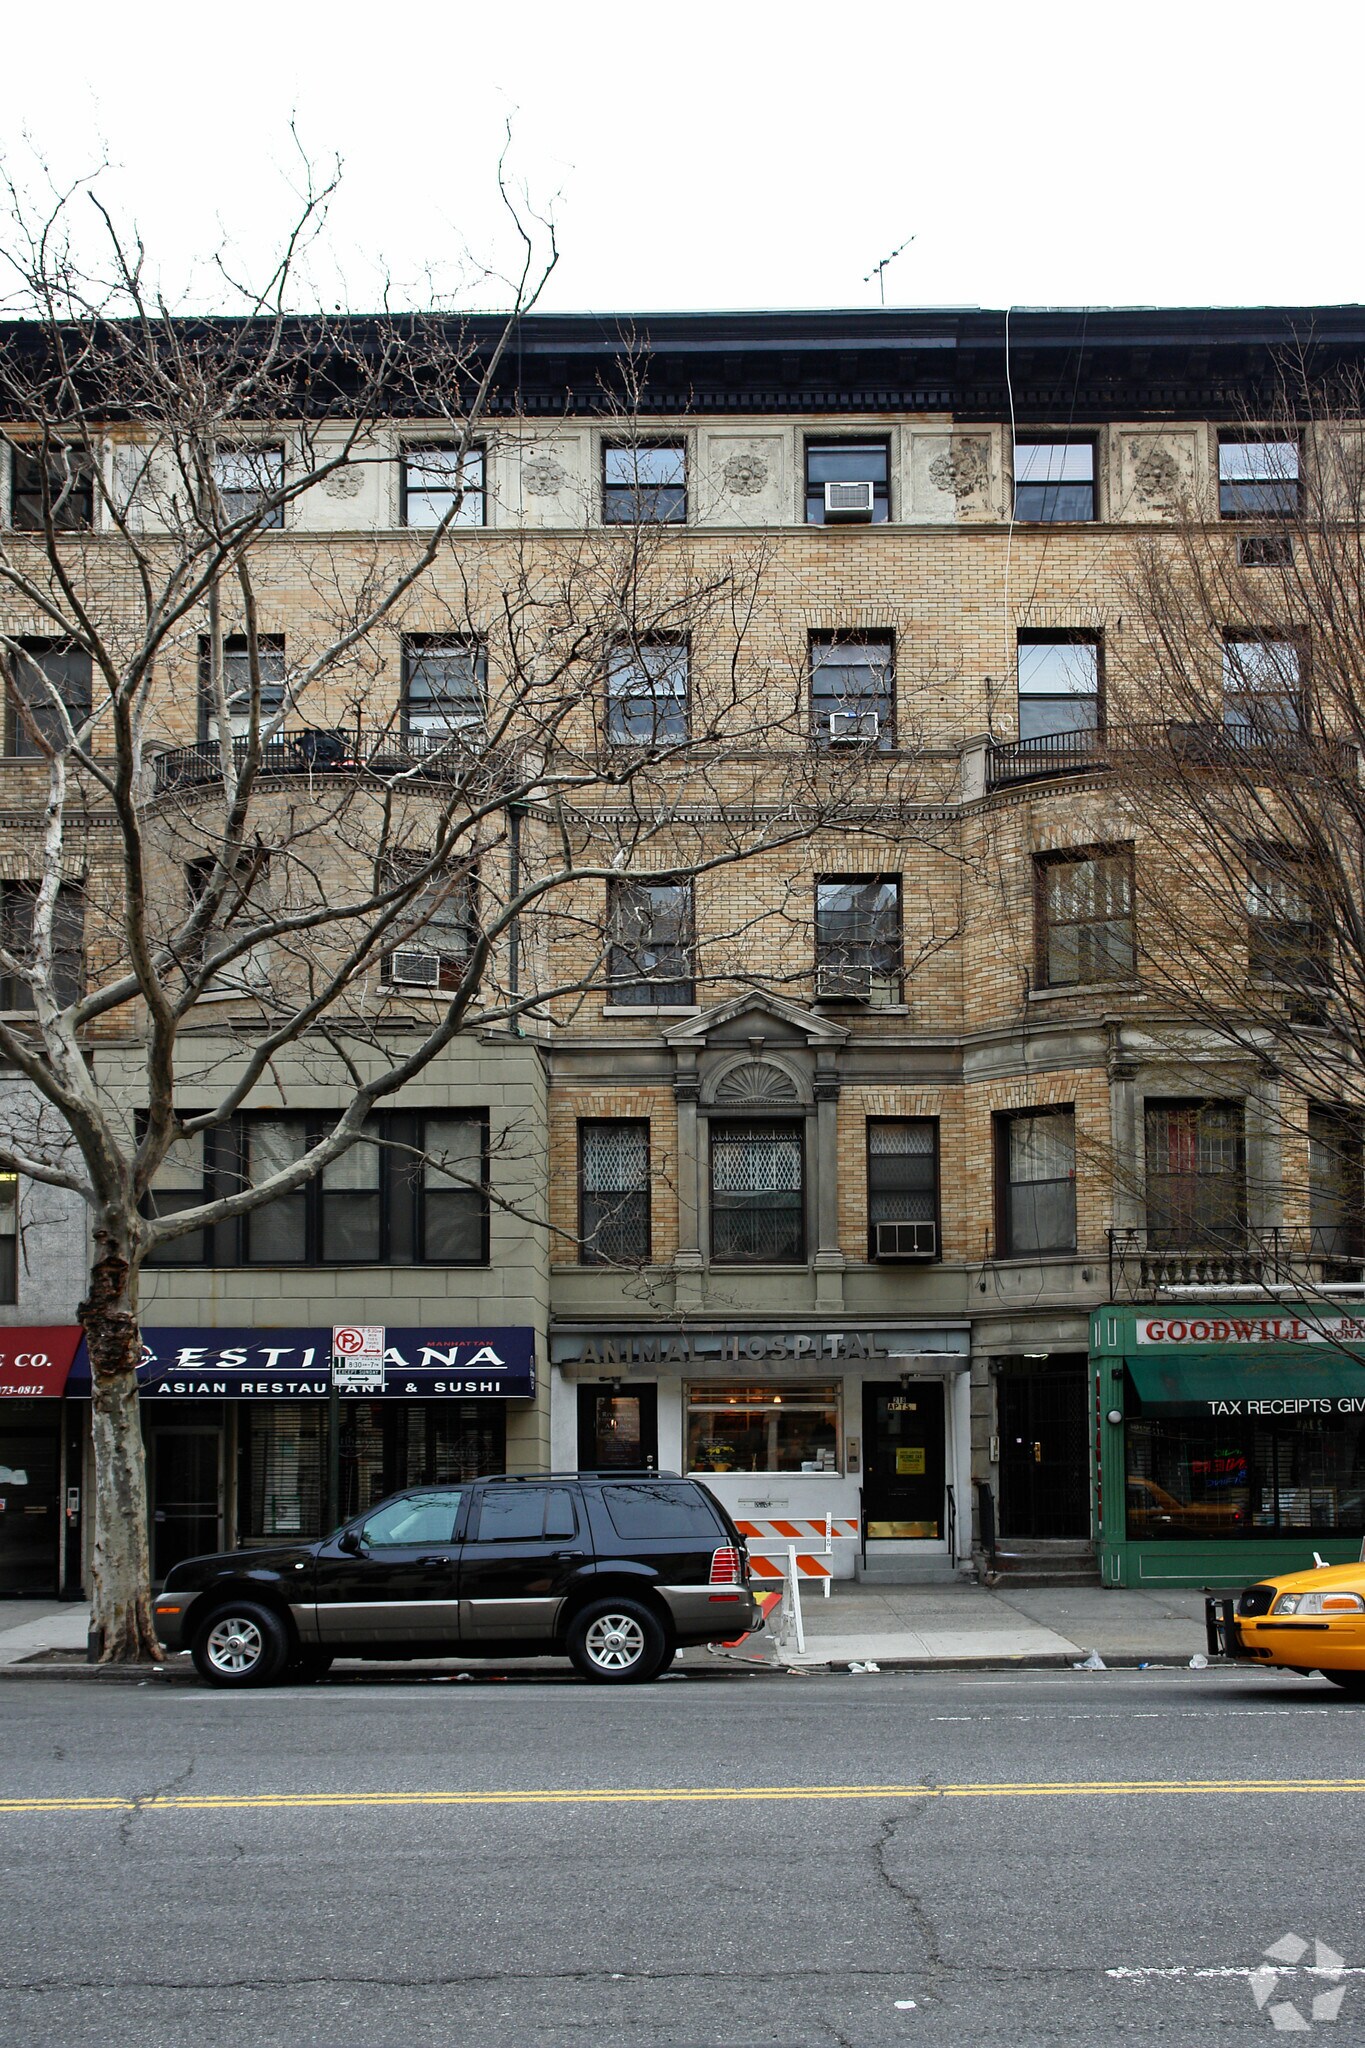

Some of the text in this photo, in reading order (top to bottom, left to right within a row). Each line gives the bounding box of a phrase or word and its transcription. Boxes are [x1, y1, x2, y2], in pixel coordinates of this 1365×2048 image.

[1146, 1320, 1307, 1341] GOODWILL
[1341, 1319, 1365, 1329] RET
[579, 1333, 888, 1363] ANIMAL HOSPITAL
[14, 1353, 52, 1367] CO.
[174, 1347, 506, 1367] ESTIANA
[0, 1386, 43, 1395] 73-0812
[158, 1382, 501, 1393] ASIAN RESTAUANT & SUSHI
[1208, 1401, 1242, 1415] TAX
[1247, 1399, 1332, 1414] RECEIPTS
